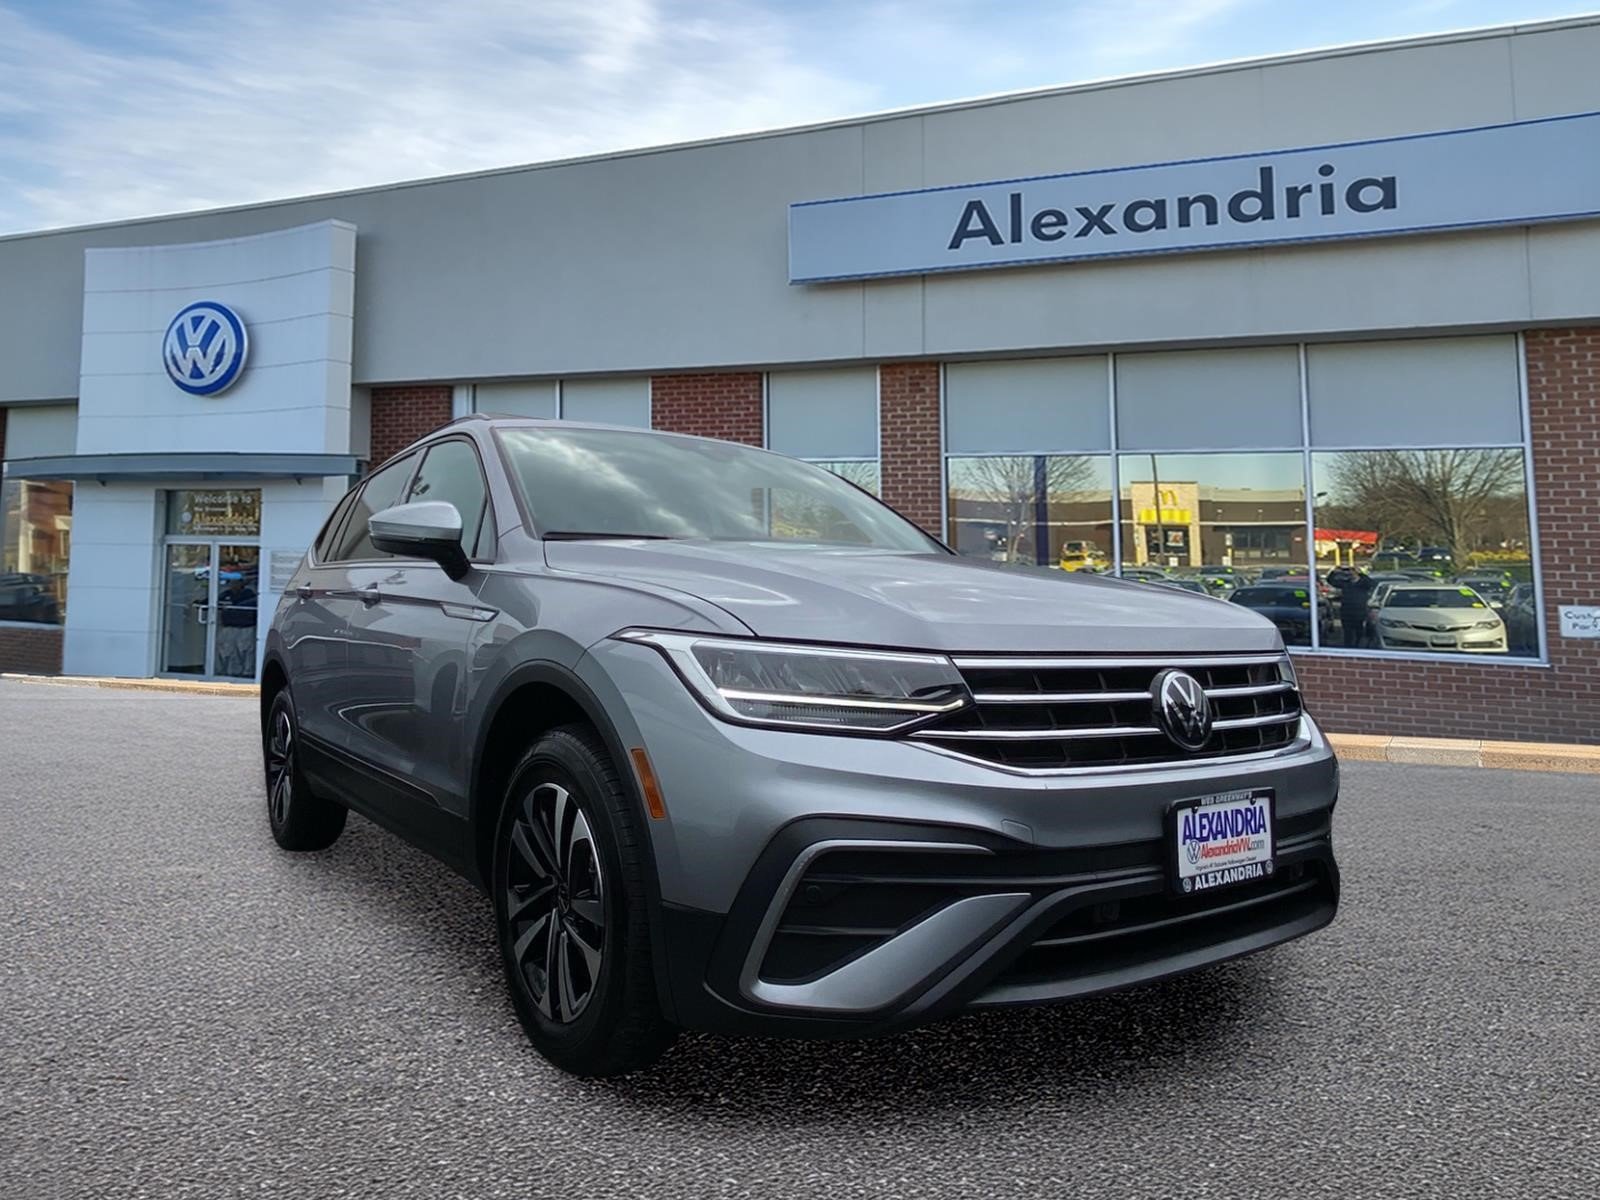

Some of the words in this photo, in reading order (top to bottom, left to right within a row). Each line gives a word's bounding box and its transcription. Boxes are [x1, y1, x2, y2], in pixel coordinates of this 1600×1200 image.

[948, 164, 1398, 250] Alexandria
[164, 306, 240, 389] VW
[1182, 806, 1267, 846] ALEXANDRIA
[1195, 863, 1263, 891] ALEXANDRIA
